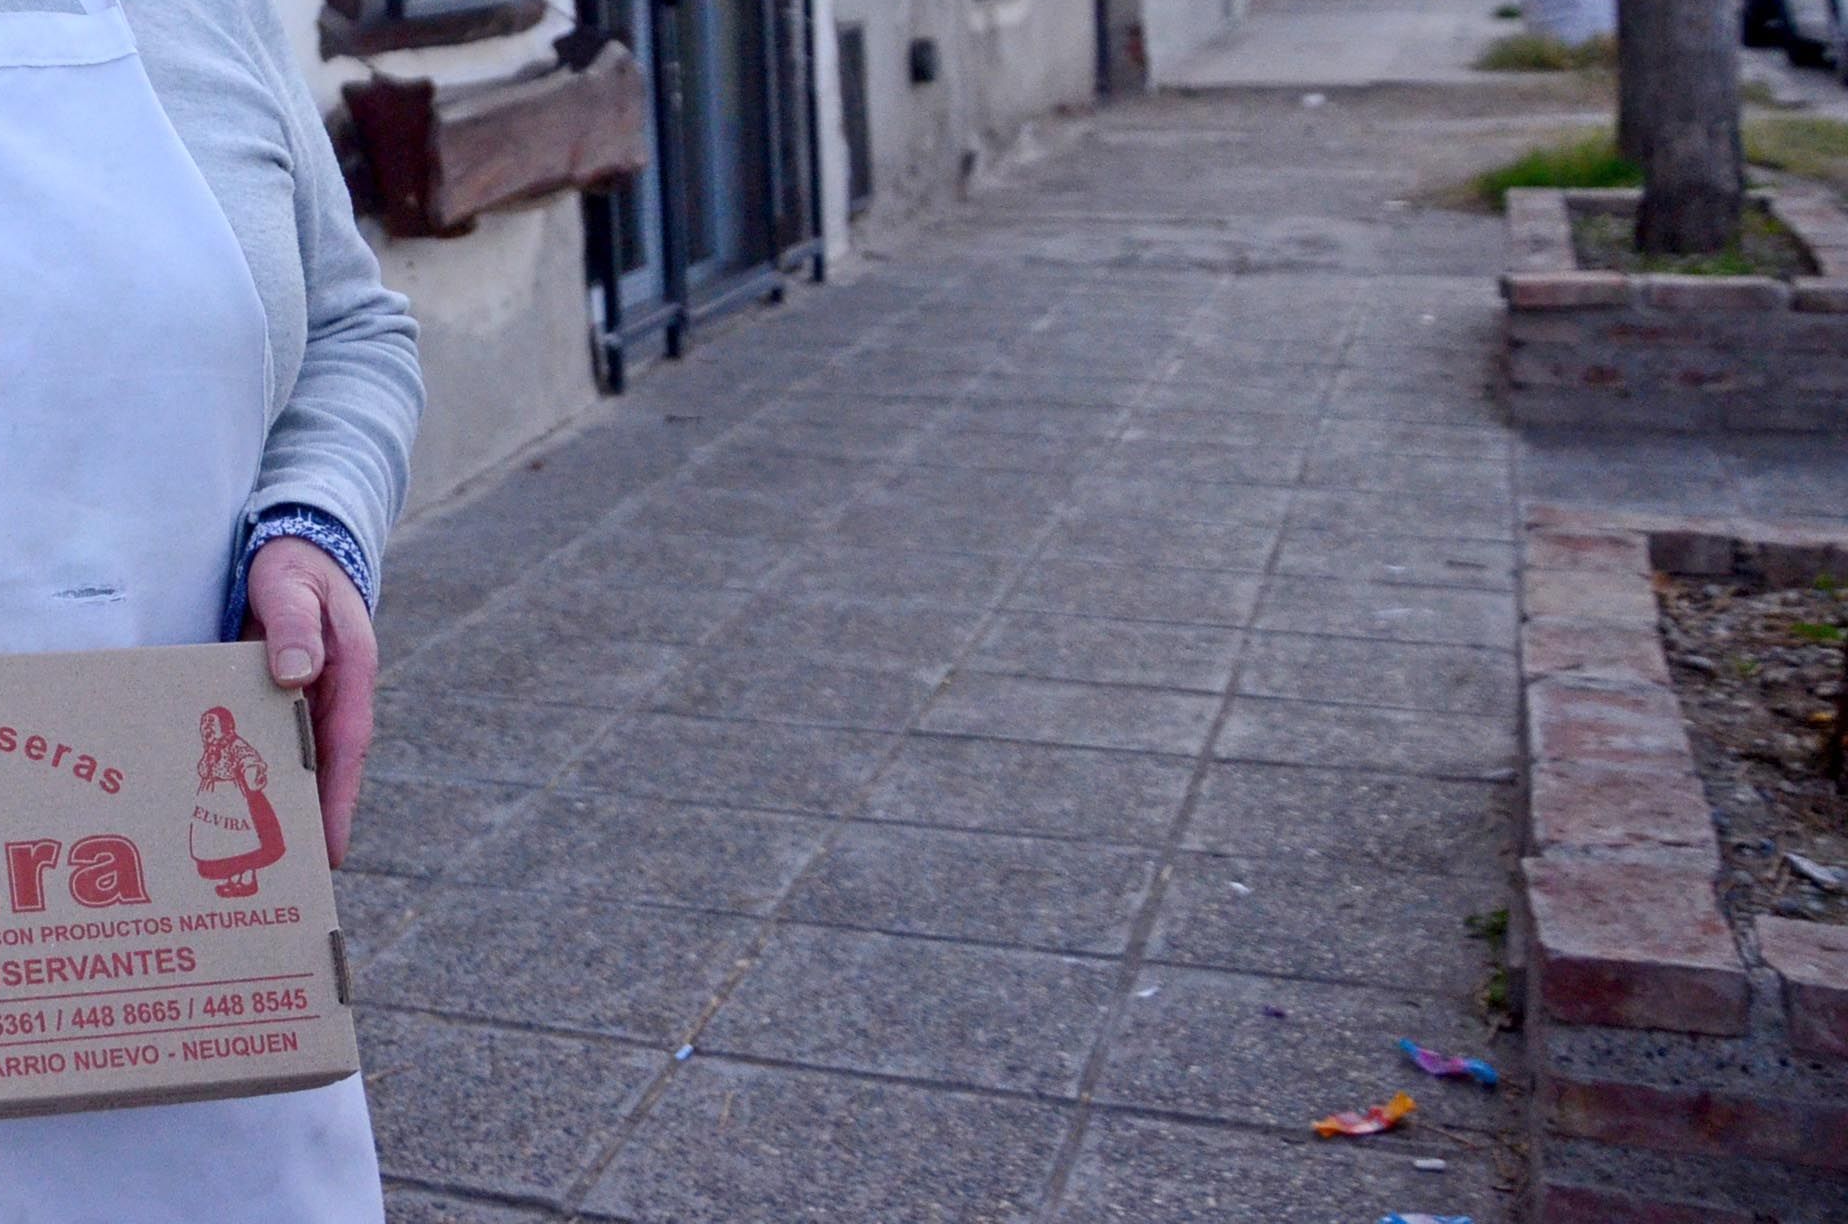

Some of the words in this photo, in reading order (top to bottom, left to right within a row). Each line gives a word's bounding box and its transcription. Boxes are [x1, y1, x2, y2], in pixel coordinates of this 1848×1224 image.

[193, 805, 251, 831] ELVIRA
[40, 917, 173, 944] PRODUCTOS
[179, 906, 301, 932] NATURALES
[56, 1009, 63, 1031] /
[71, 1006, 115, 1029] 448
[123, 999, 181, 1026] 8665
[188, 997, 194, 1019] /
[202, 993, 244, 1018] 448
[252, 988, 308, 1013] 8545
[73, 1044, 159, 1071] NUEVO
[182, 1031, 298, 1062] NEUQUEN
